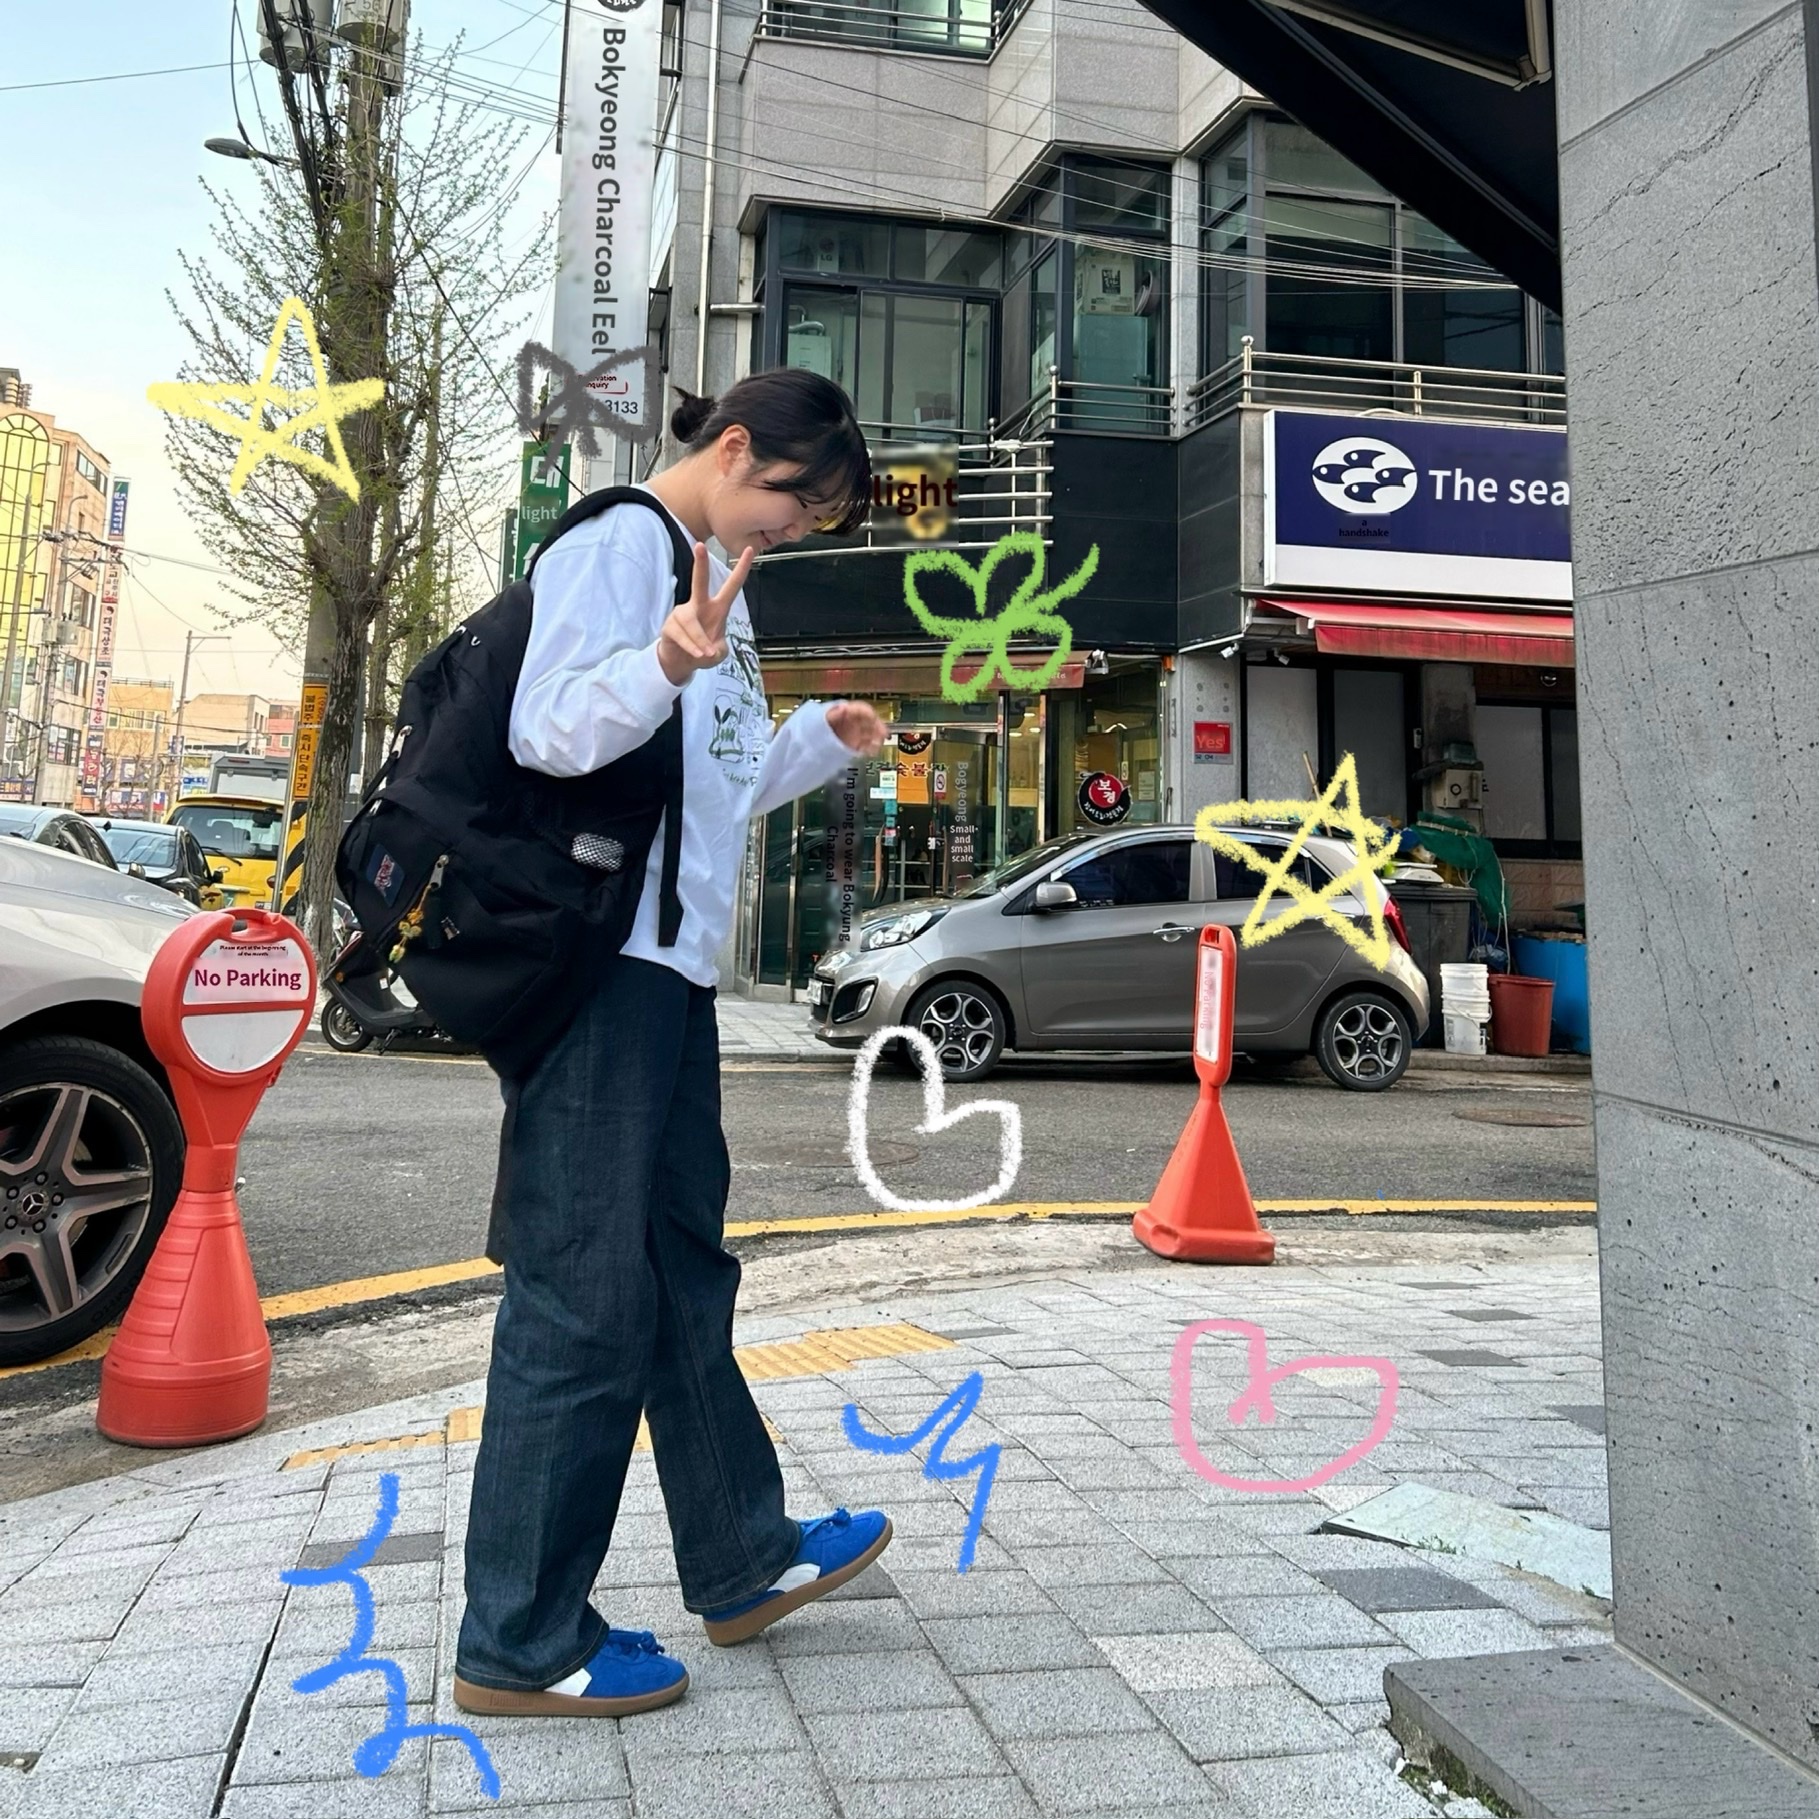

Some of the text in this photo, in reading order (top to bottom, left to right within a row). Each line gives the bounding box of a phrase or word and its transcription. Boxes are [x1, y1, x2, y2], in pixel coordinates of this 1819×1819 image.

[592, 28, 626, 171] Bokyeong
[592, 178, 621, 304] Charcoal
[591, 316, 616, 354] Eel
[873, 474, 958, 516] light
[1428, 468, 1570, 506] The sea
[522, 506, 558, 523] light
[1338, 527, 1390, 537] handshake
[1196, 735, 1224, 749] Yes
[955, 762, 969, 822] Bogyeong
[825, 826, 839, 883] Charcoal
[838, 767, 858, 941] I'm going to wear Bokyung
[951, 845, 974, 853] small
[952, 854, 973, 862] scale
[955, 835, 971, 843] and
[194, 968, 302, 990] No Parking
